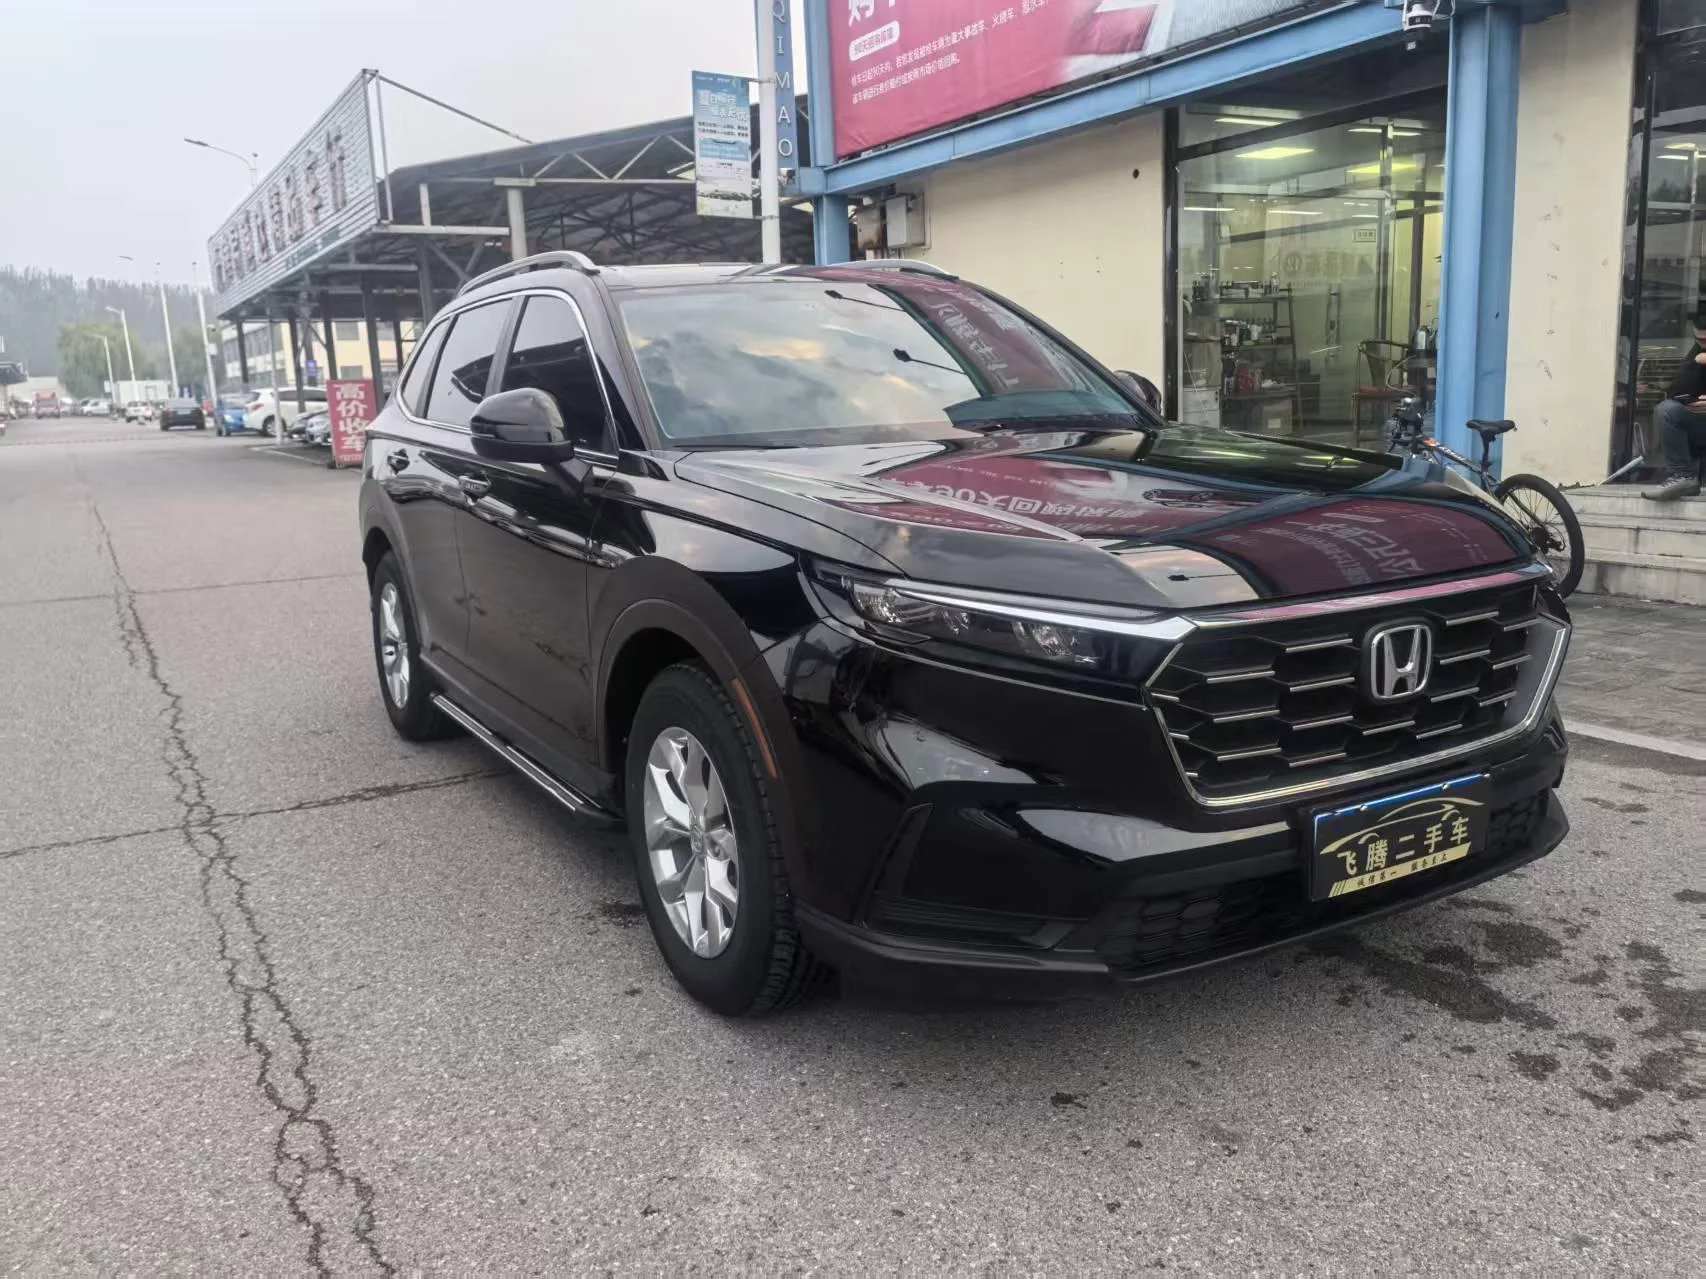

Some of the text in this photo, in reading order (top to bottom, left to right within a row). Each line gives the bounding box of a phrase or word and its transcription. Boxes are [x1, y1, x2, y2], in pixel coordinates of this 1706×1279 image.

[1336, 816, 1470, 876] 飞腾二手车
